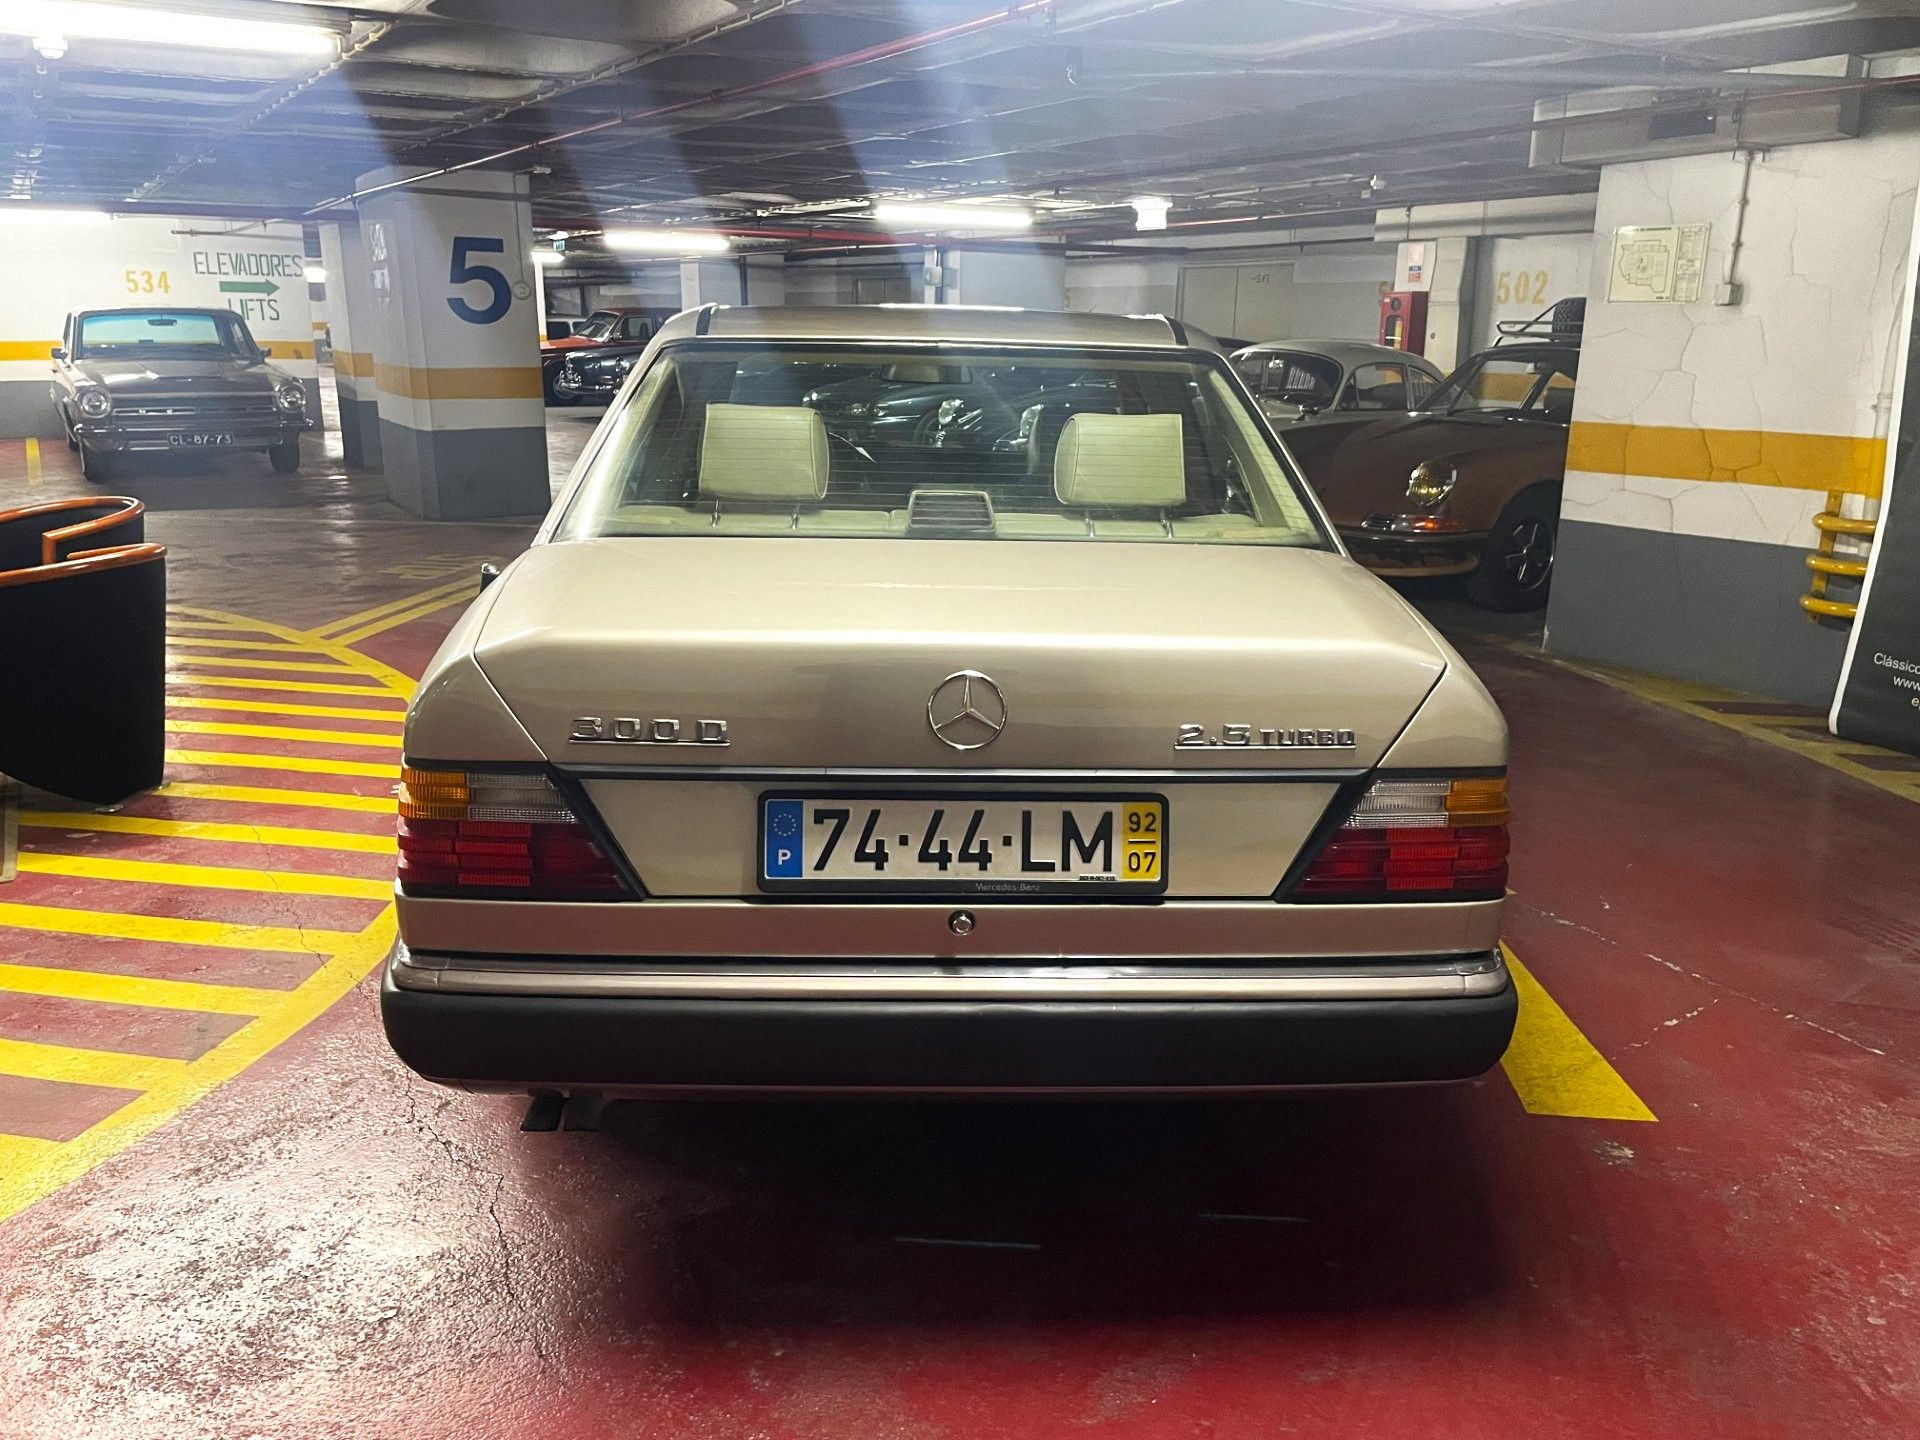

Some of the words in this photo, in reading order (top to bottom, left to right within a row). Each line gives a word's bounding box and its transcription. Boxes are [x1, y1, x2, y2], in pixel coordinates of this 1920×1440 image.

[193, 251, 304, 277] ELEVADORES
[125, 269, 171, 294] 534
[447, 236, 512, 325] 5
[1497, 271, 1548, 304] 502
[571, 716, 681, 740] 300
[696, 719, 728, 741] D
[1175, 723, 1251, 745] 2.5
[1259, 728, 1356, 745] TURBO
[1128, 812, 1157, 833] 92
[777, 849, 792, 866] P
[1128, 851, 1157, 872] 07
